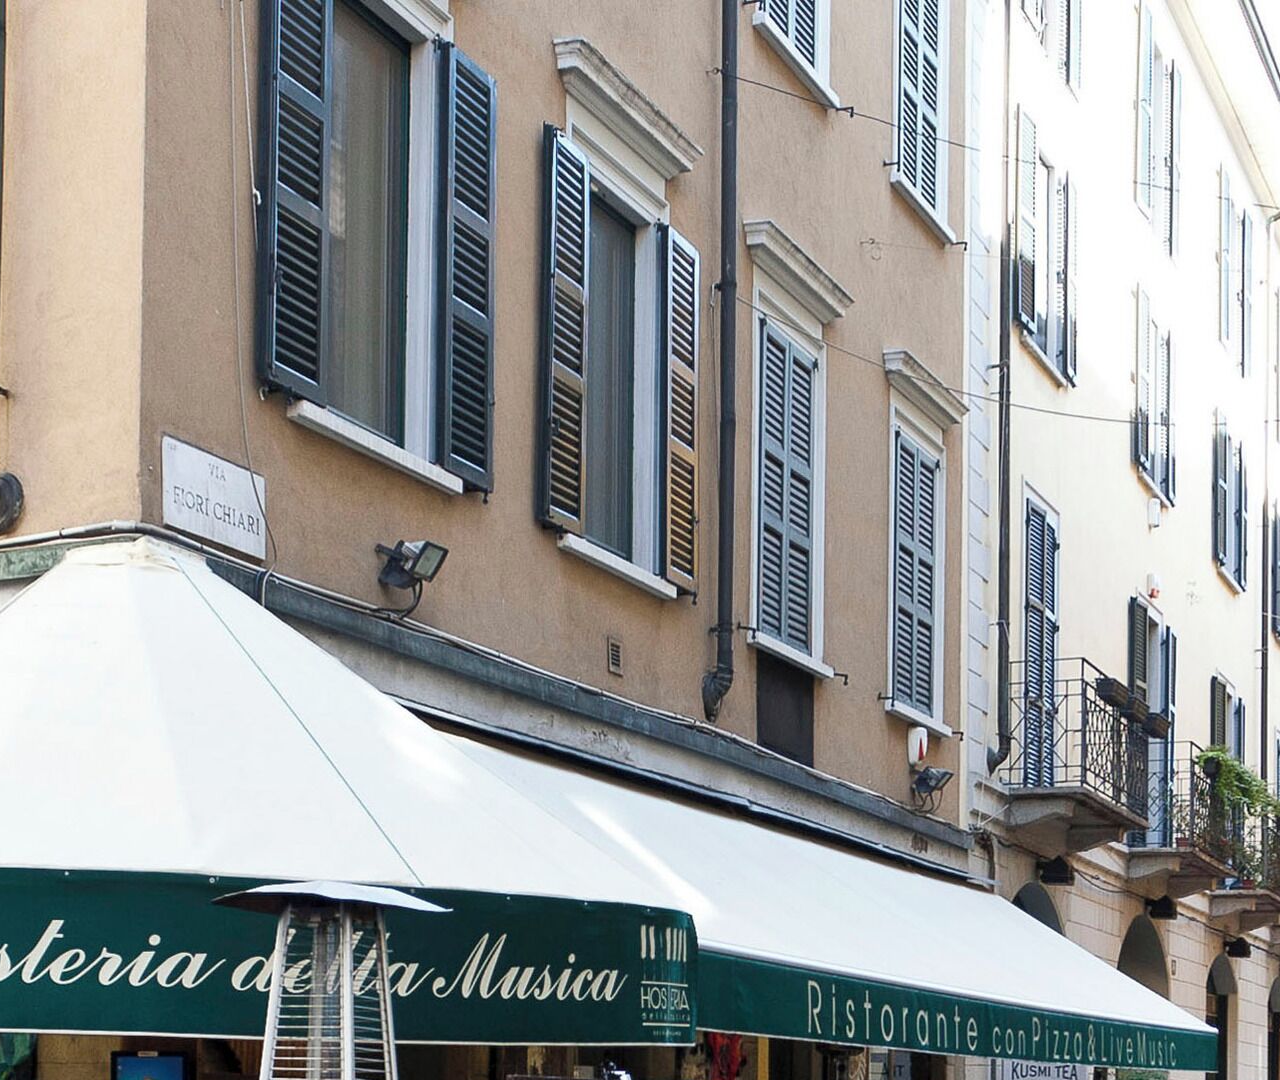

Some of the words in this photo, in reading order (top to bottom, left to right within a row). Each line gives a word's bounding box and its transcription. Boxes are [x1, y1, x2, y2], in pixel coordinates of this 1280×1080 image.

[208, 463, 227, 482] VIA
[173, 485, 210, 517] FIORI
[213, 502, 261, 536] CHIARI
[431, 932, 628, 1001] Musica
[807, 979, 979, 1052] Ristorante
[992, 1026, 1026, 1056] con
[1032, 1016, 1083, 1061] Pizza
[1011, 1061, 1051, 1080] KUSMI
